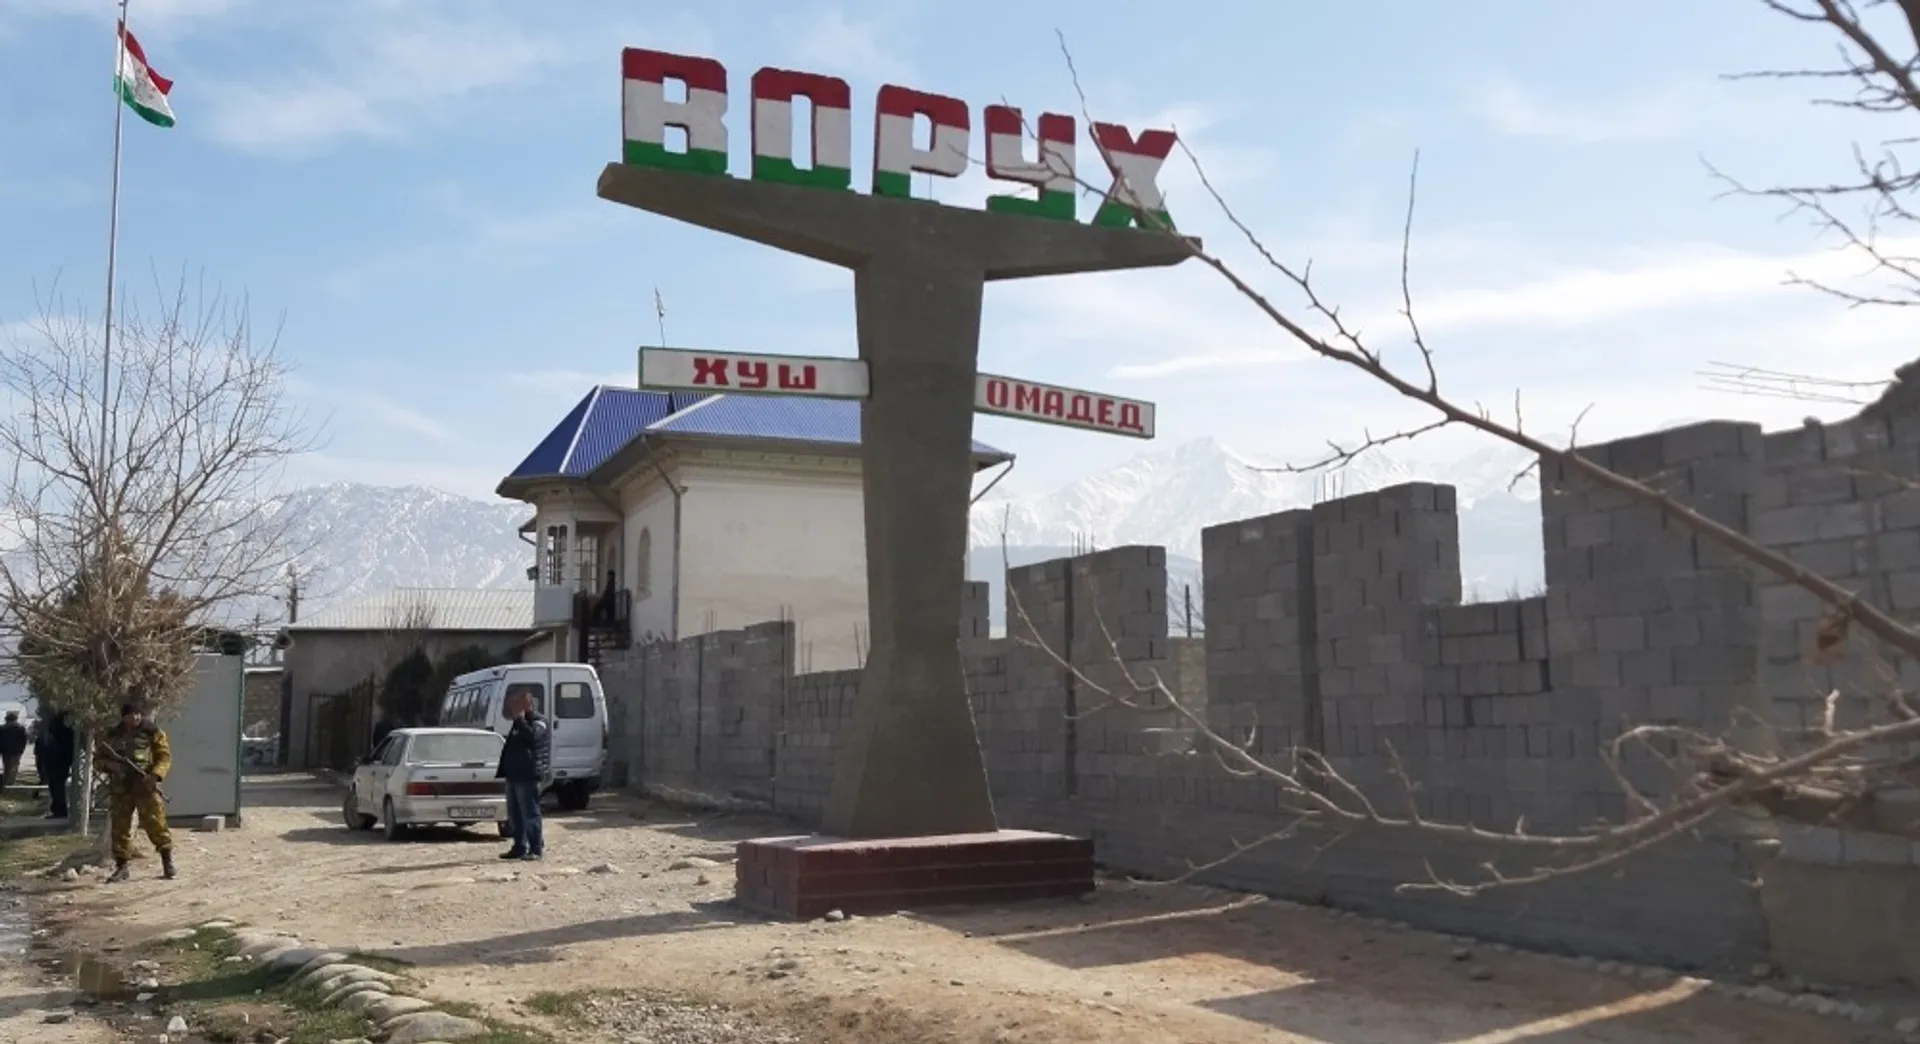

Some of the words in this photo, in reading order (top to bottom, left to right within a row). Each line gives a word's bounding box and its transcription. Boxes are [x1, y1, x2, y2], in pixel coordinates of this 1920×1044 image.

[622, 47, 1177, 231] ВОРУХ
[692, 357, 816, 390] ХУШ
[986, 379, 1144, 432] ОМАДЕД
